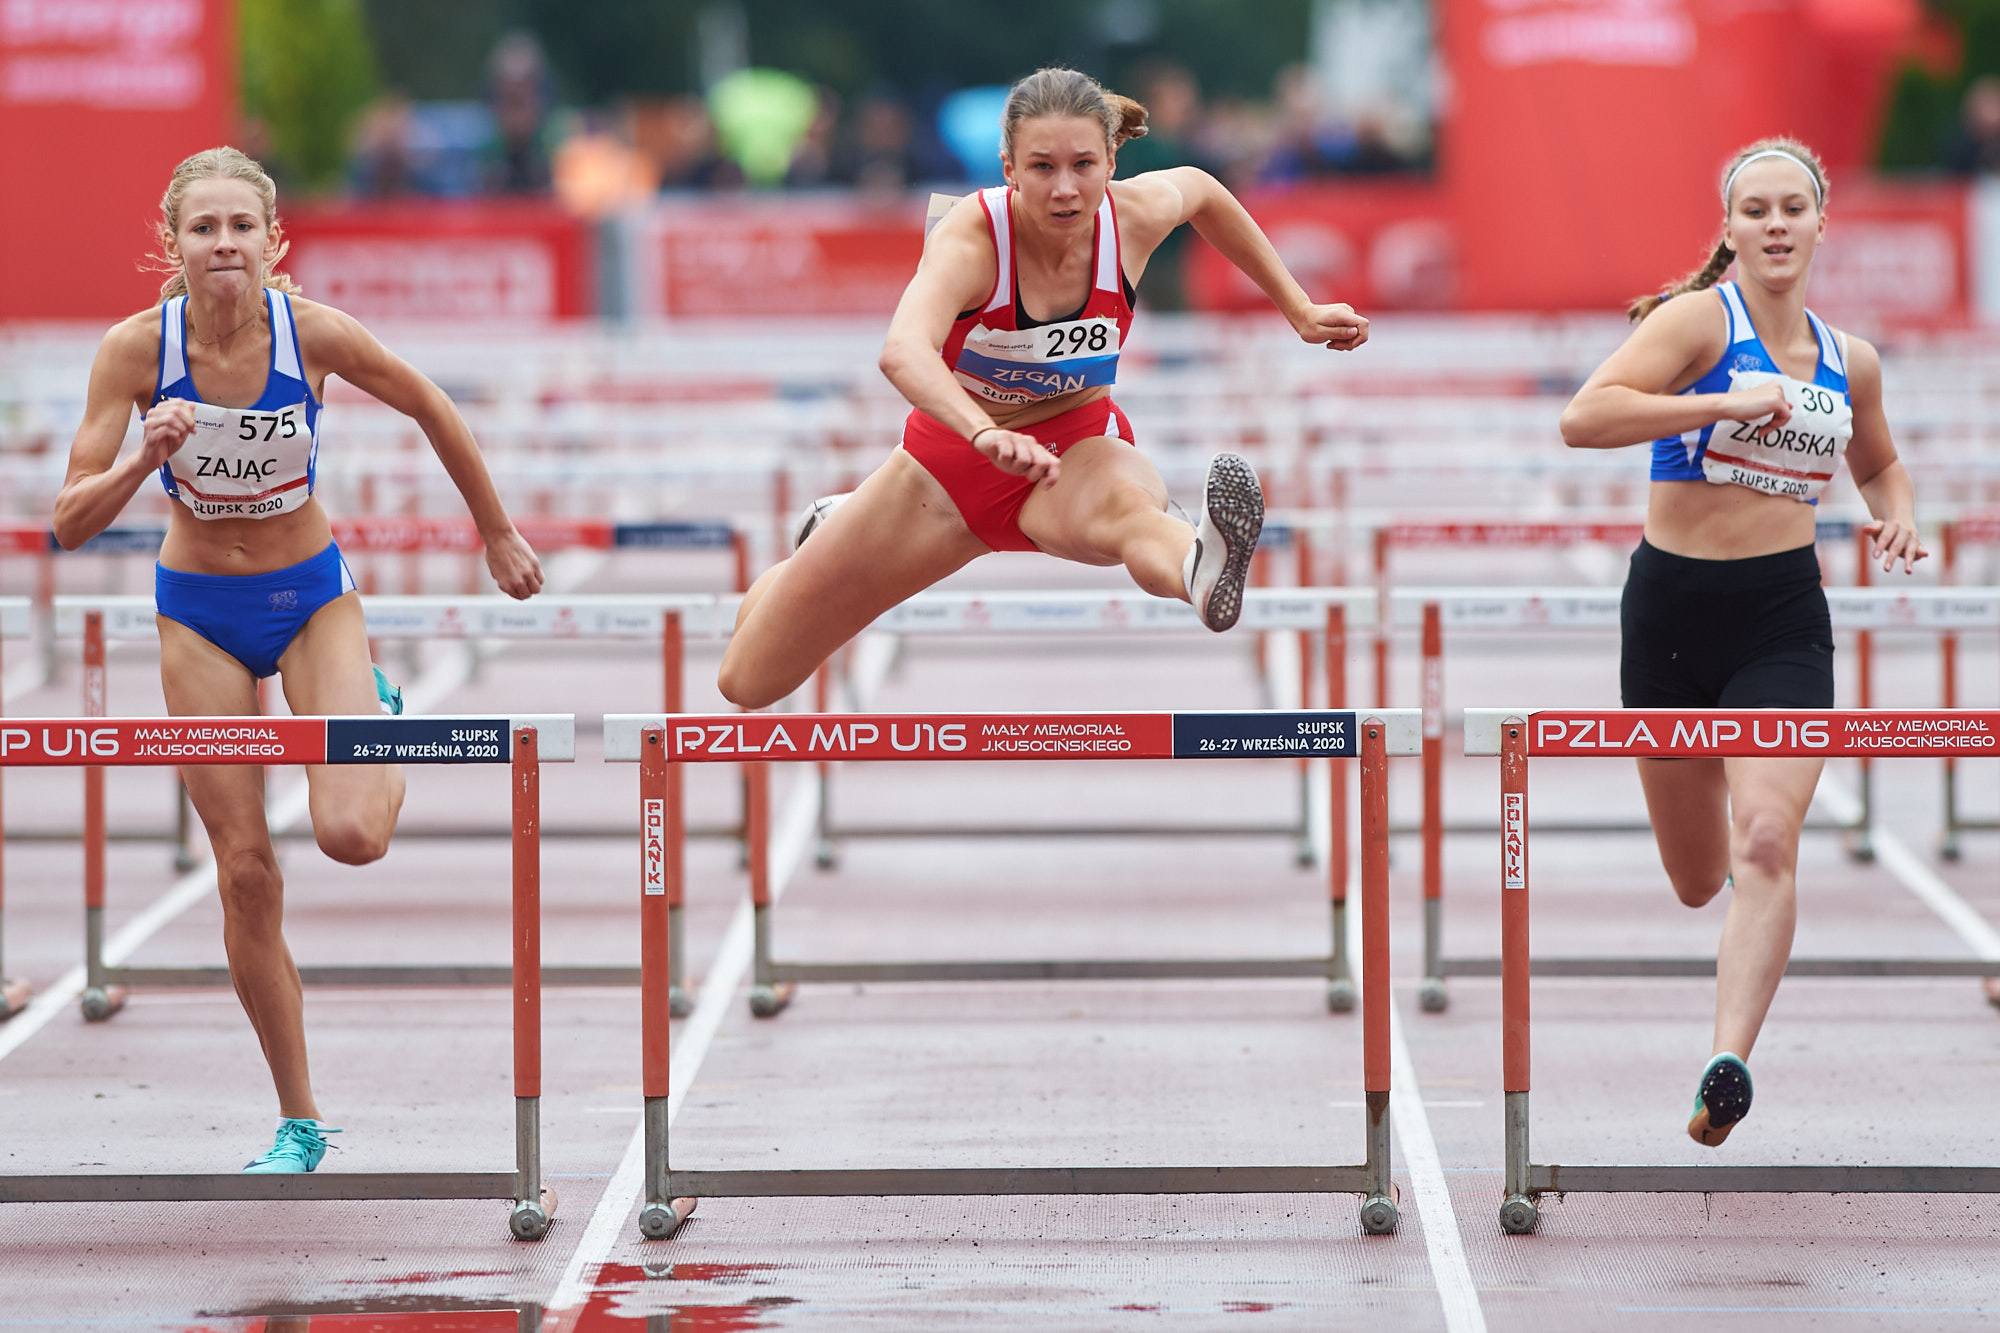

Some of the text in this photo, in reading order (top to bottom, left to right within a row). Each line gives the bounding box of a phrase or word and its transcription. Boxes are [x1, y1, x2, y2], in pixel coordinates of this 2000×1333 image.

[1045, 323, 1108, 358] 298
[992, 368, 1086, 390] ZEGAN
[982, 386, 1034, 404] SŁUPS
[1801, 387, 1834, 414] 30
[195, 419, 225, 429] el-sport.pl
[238, 410, 297, 442] 575
[1730, 420, 1836, 458] ZAORSKA
[196, 455, 278, 483] ZAJĄC
[1731, 469, 1778, 491] SŁUPSK
[1781, 481, 1809, 495] 2020
[193, 500, 244, 515] SŁUPSK
[249, 497, 283, 514] 2020
[134, 728, 279, 740] MAŁY MEMORIAŁ
[981, 724, 1126, 736] MAŁY MEMORIAŁ
[1297, 722, 1345, 735] SŁUPSK
[1537, 719, 1830, 748] PZLA MP U16
[1844, 719, 1989, 732] MAŁY MEMORIAŁ
[1, 728, 120, 757] P U16
[451, 729, 499, 742] SŁUPSK
[676, 723, 967, 754] PZLA MP U16
[1199, 735, 1345, 751] 26-27 WRZEŚNIA 2020
[1844, 734, 1996, 748] J.KUSOCIŃSKIEGO
[134, 742, 285, 756] J.KUSOCIŃSKIEGO
[353, 742, 499, 757] 26-27 WRZEŚNIA 2020
[981, 738, 1132, 752] J.KUSOCIŃSKIEGO
[647, 802, 662, 884] POLANIK
[1506, 796, 1522, 878] POLANIK
